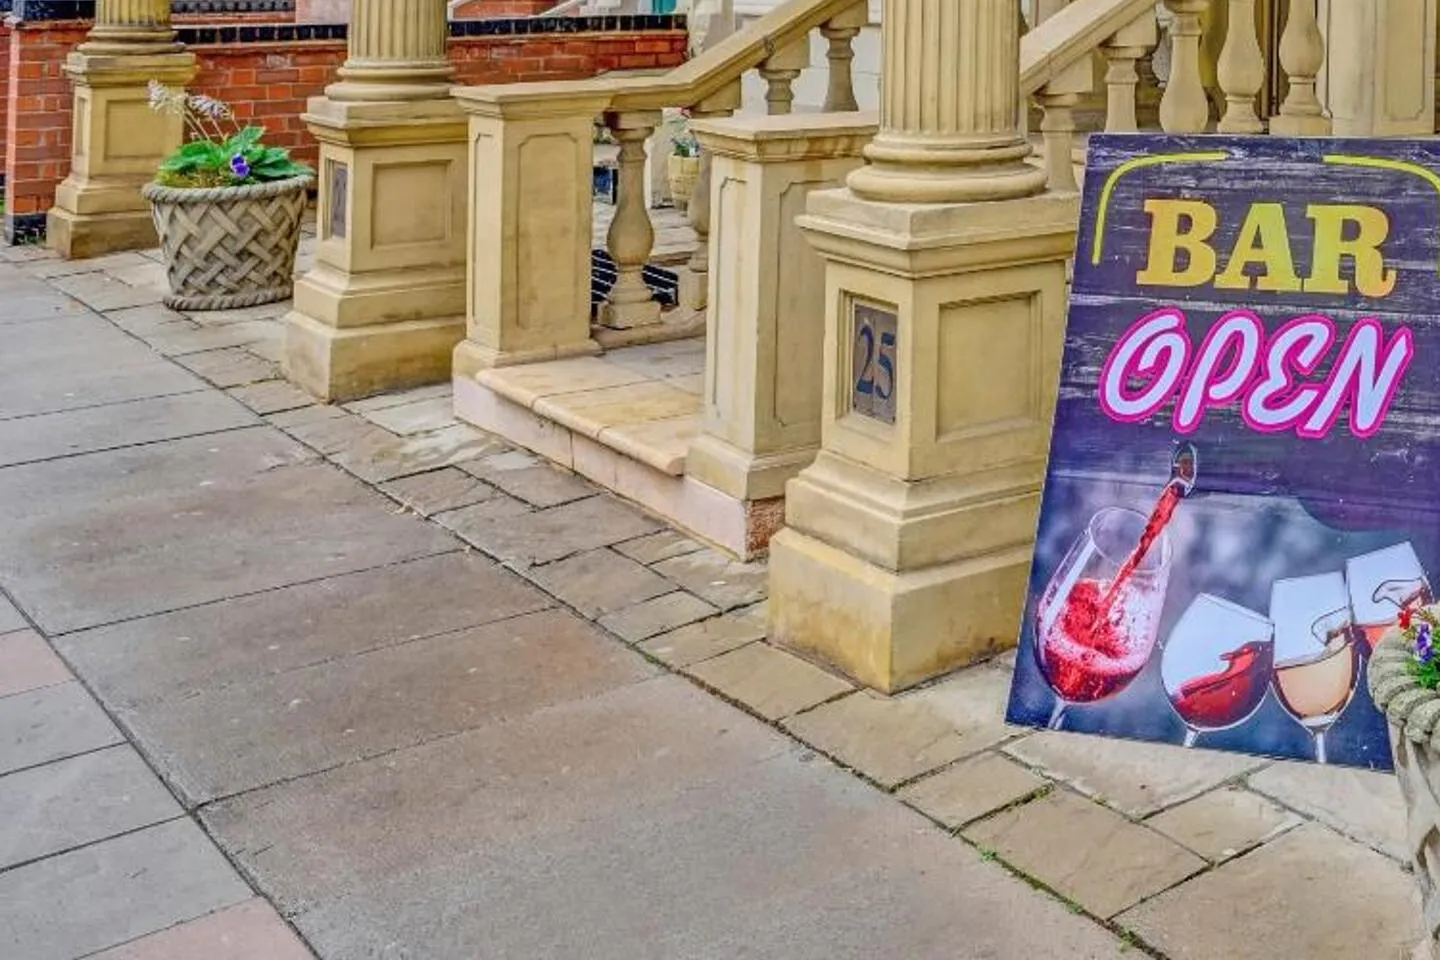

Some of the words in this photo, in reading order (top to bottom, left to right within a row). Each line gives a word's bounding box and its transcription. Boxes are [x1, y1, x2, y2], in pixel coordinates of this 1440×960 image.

[1136, 198, 1397, 297] BAR
[856, 324, 896, 401] 25
[1100, 308, 1413, 438] OPEN
